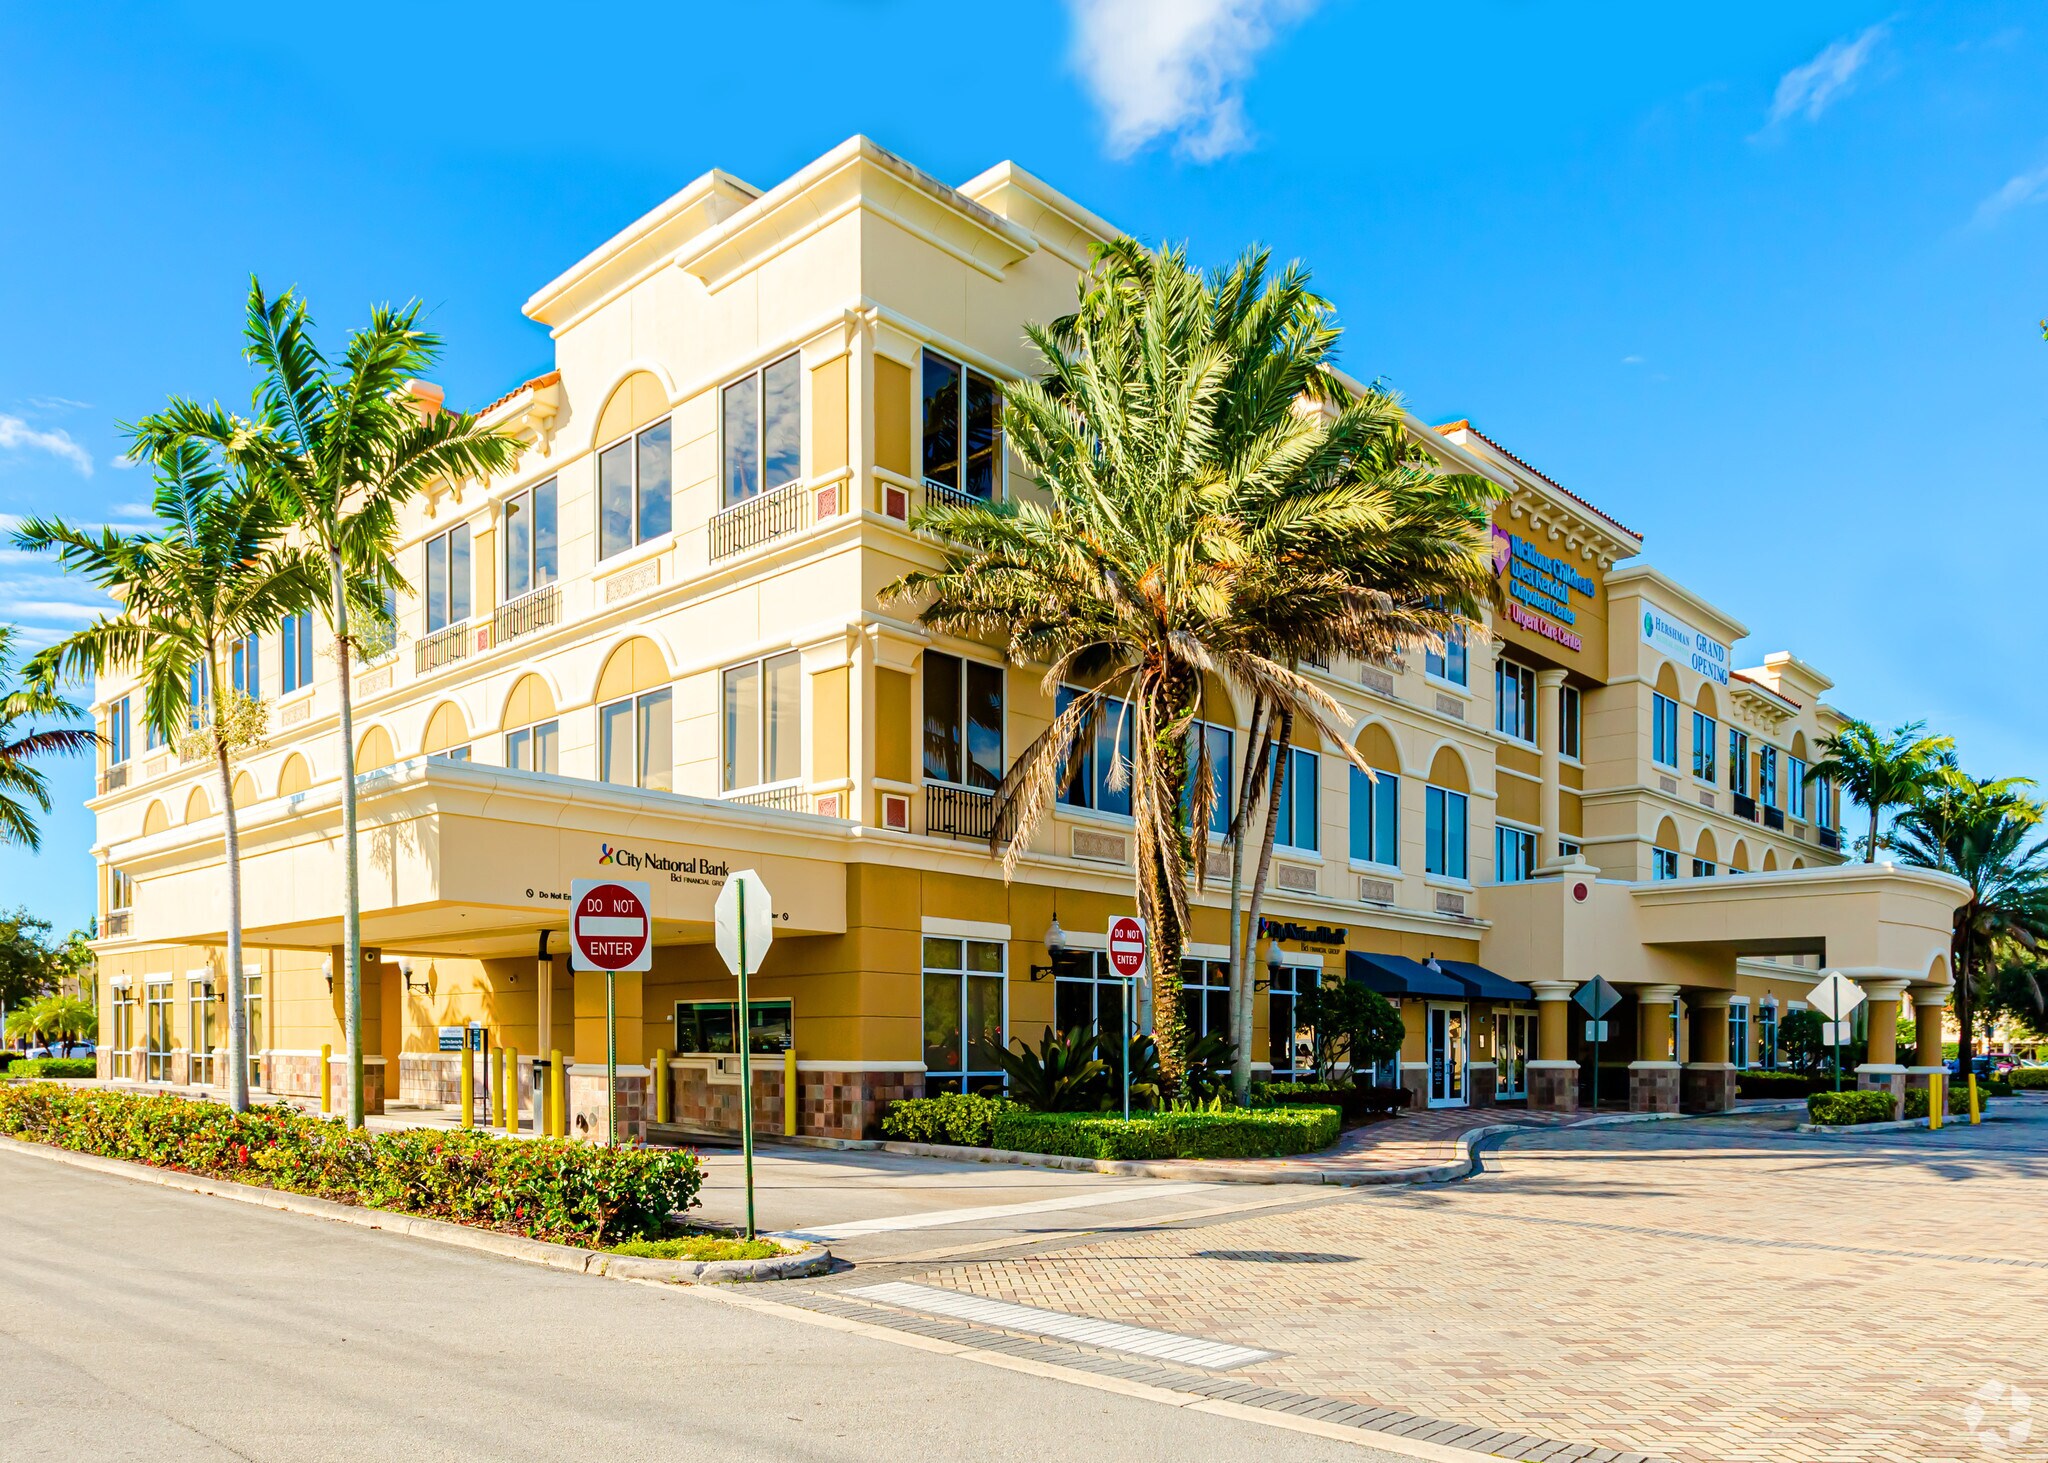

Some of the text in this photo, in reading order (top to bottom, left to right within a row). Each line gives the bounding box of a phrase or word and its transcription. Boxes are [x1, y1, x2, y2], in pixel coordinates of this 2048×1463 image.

[1510, 533, 1552, 575] Nicklaus
[1510, 556, 1570, 605] West Kendall
[1510, 579, 1576, 625] Outpatient Center
[1511, 603, 1582, 652] Urgent Care Center
[1655, 616, 1690, 646] HERSHMAN
[1696, 633, 1724, 663] GRAND
[1691, 653, 1728, 686] OPENING
[616, 849, 729, 876] City National Bank
[683, 877, 710, 885] FINANCIAL
[587, 898, 635, 913] DO NOT
[590, 941, 633, 956] ENTER
[1114, 928, 1140, 939] DO NOT
[1117, 954, 1138, 965] ENTER
